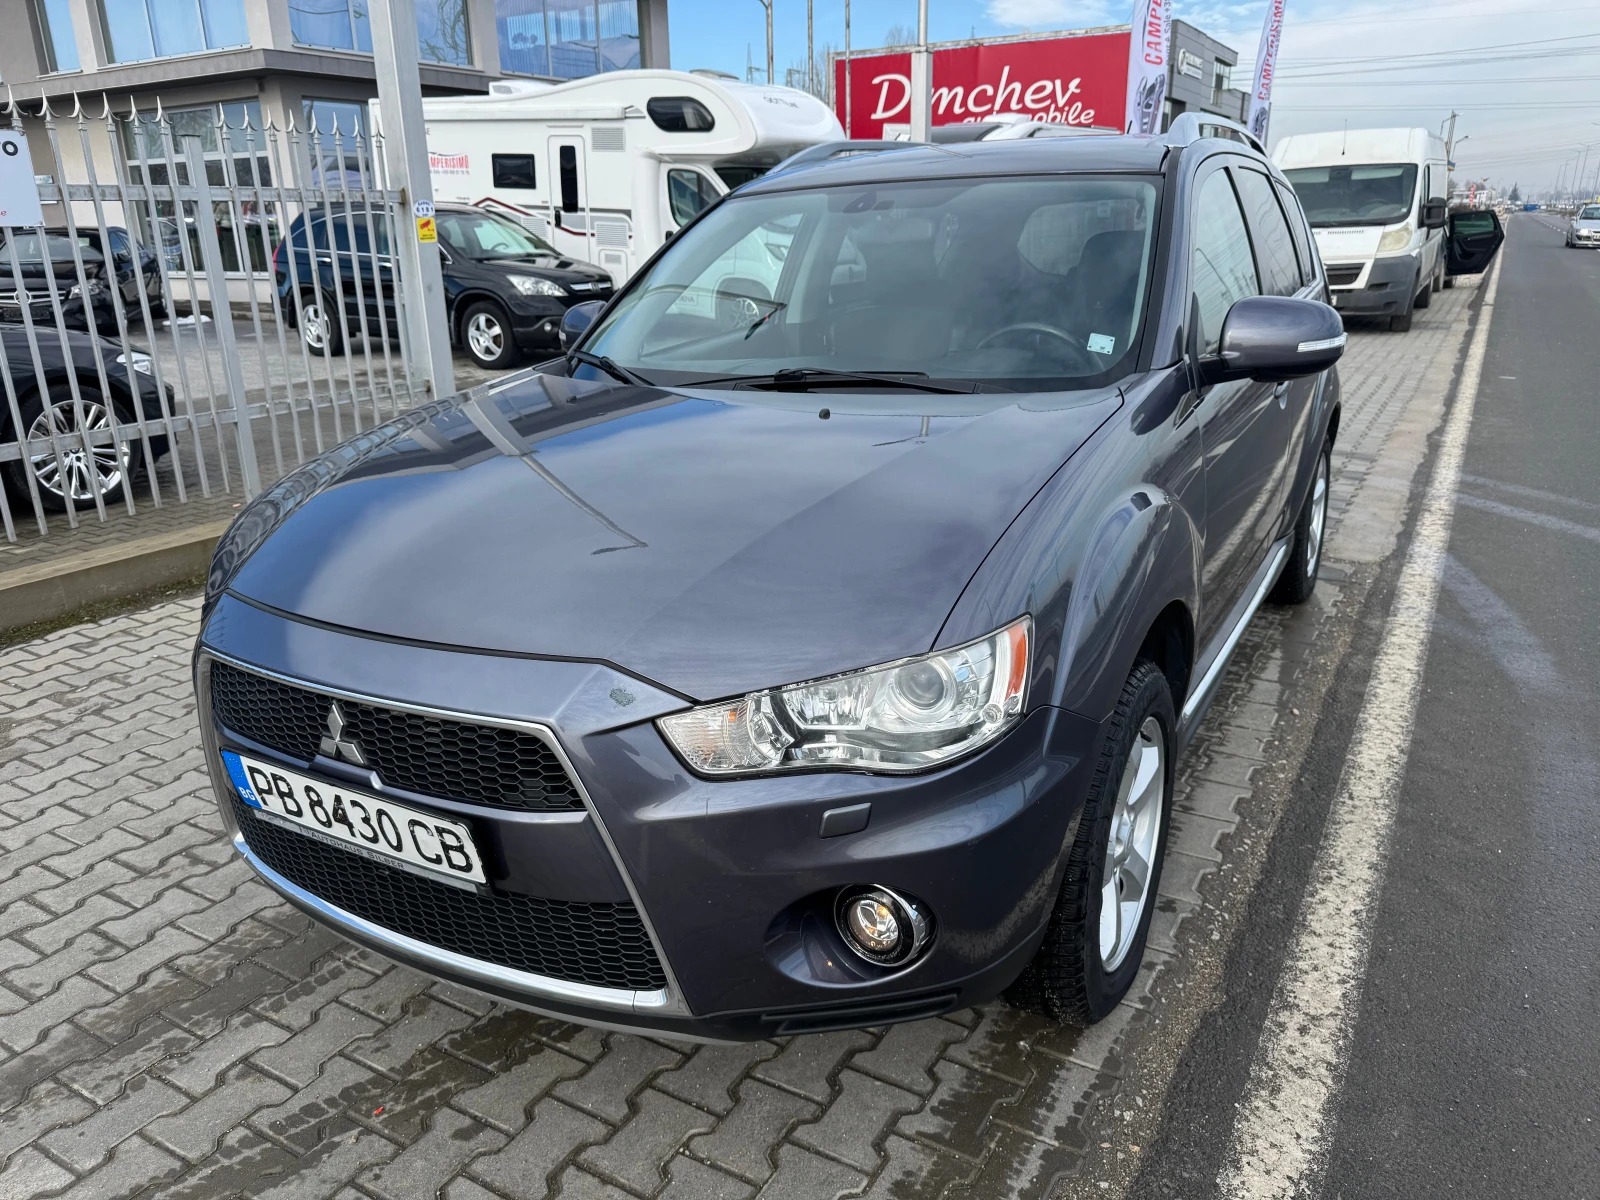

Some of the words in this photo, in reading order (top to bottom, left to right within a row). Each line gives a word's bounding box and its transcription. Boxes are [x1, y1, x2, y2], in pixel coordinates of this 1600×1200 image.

[870, 65, 1081, 120] Dmchev
[238, 786, 256, 801] BG
[247, 764, 304, 818] PB
[304, 784, 403, 853] 8430
[408, 818, 474, 873] CB
[311, 832, 363, 856] AUTOHAUS
